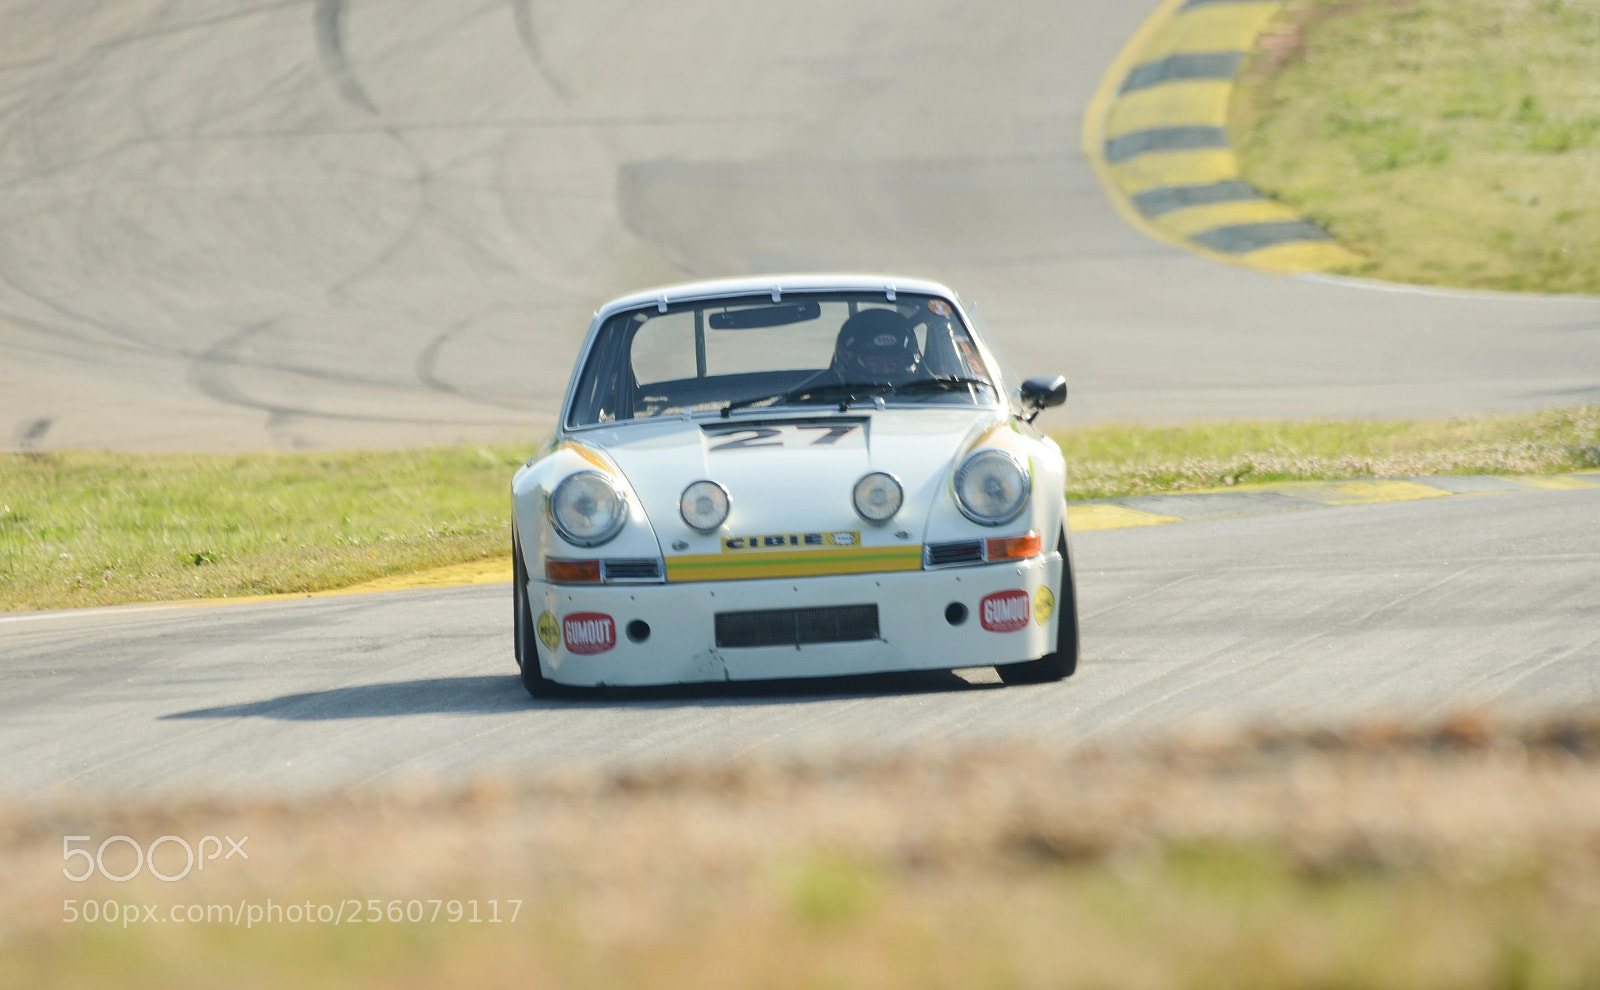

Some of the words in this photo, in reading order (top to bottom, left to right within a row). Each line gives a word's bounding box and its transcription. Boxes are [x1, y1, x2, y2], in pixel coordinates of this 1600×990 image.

[708, 423, 862, 452] 27
[725, 533, 823, 550] CIBIE
[983, 595, 1029, 625] GUMOUT
[565, 619, 612, 645] GUMOUT
